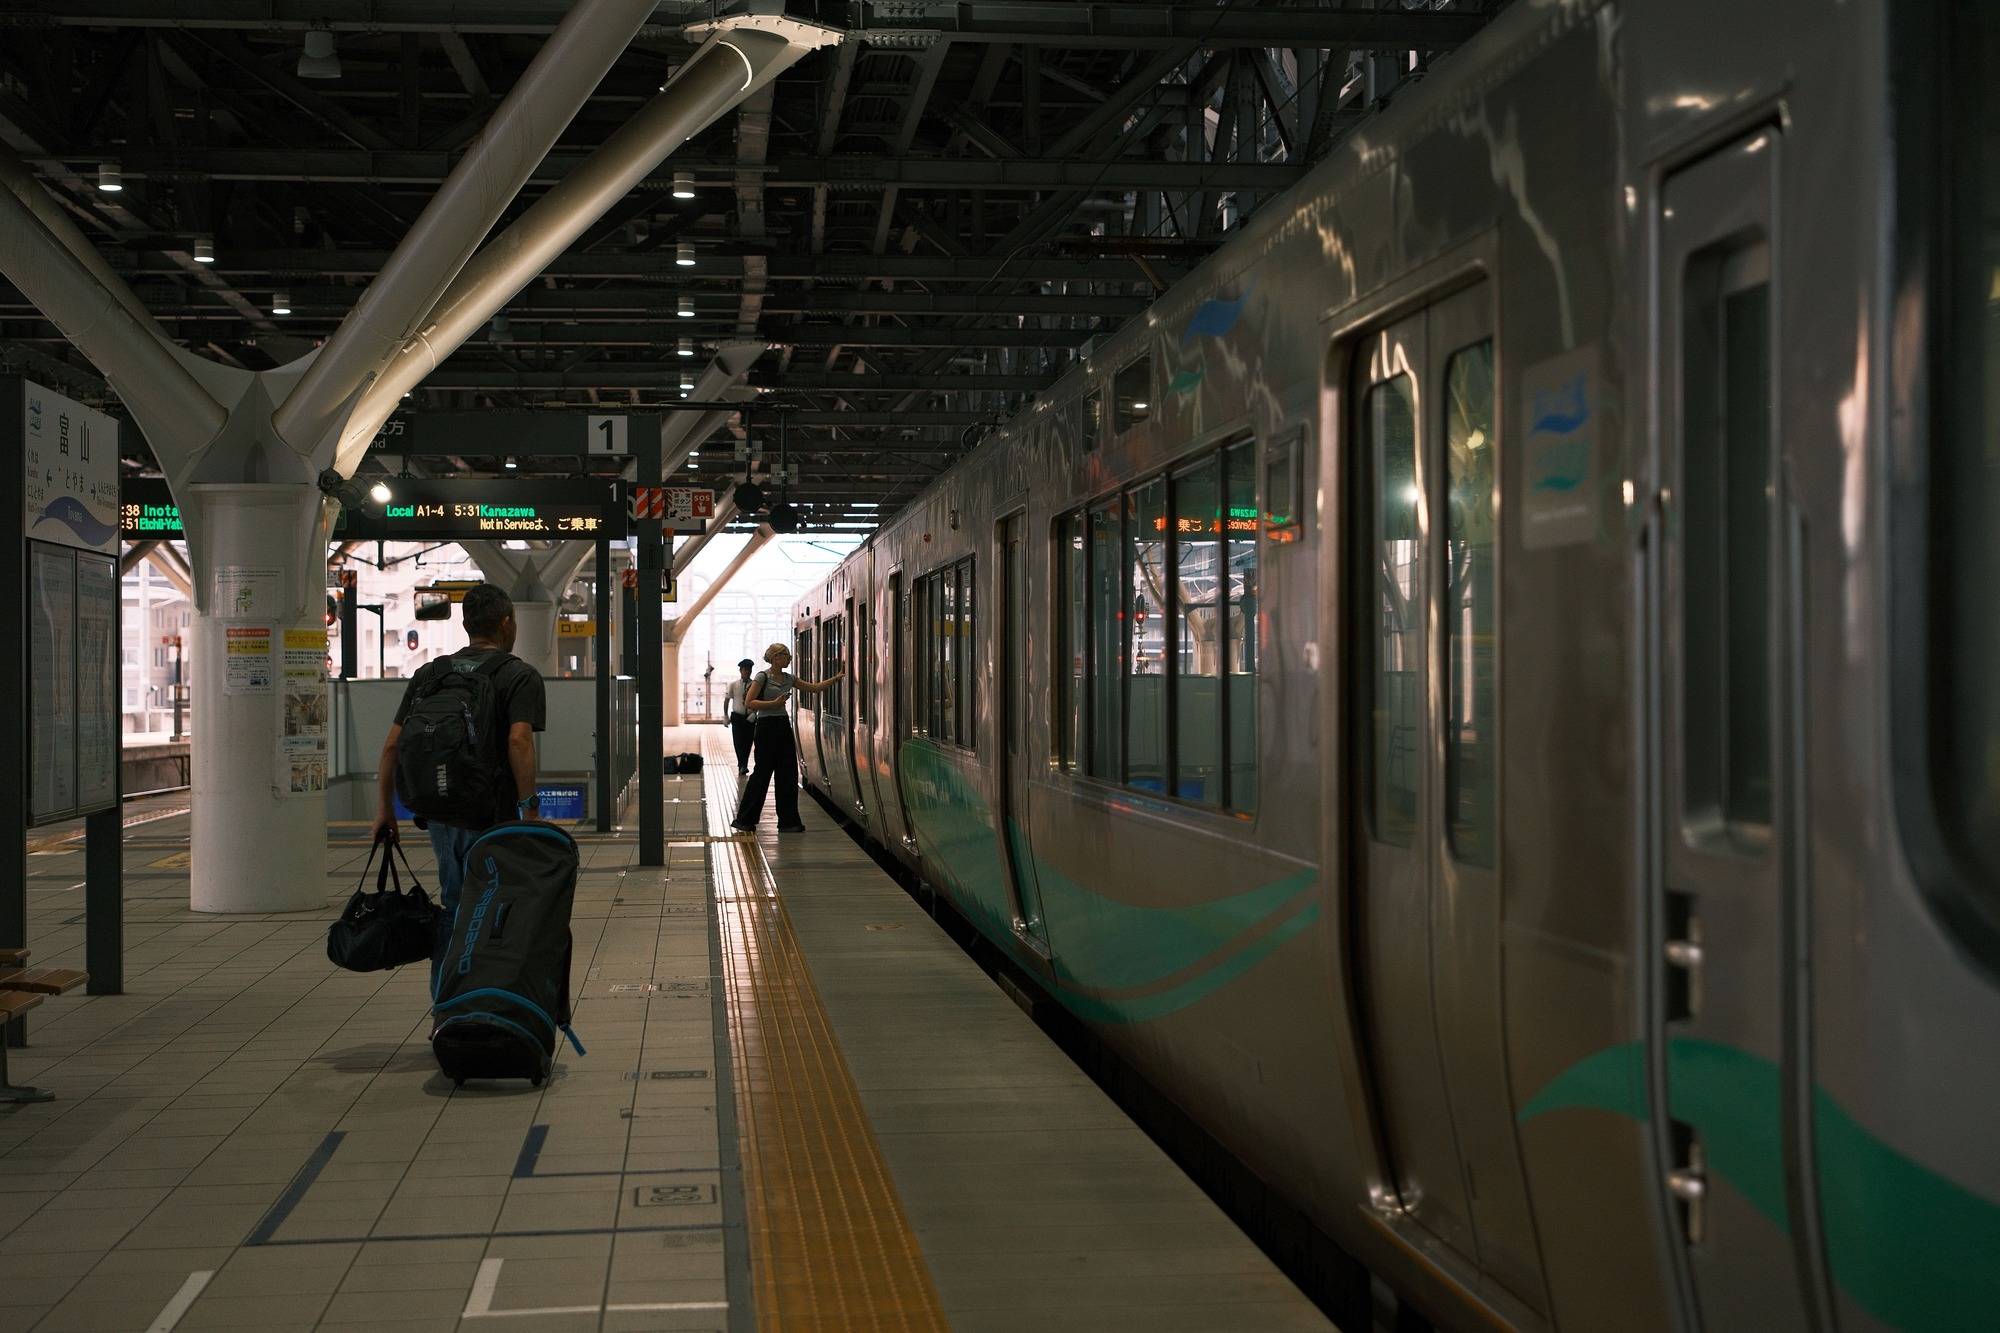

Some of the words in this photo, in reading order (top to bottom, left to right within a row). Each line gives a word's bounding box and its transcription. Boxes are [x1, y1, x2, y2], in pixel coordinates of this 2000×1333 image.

[59, 412, 90, 464] 富山
[598, 419, 614, 451] 1
[65, 468, 84, 493] とやま
[608, 482, 618, 503] 1
[694, 494, 711, 502] SOS
[386, 504, 414, 517] Local
[454, 504, 480, 517] 5:31
[480, 504, 536, 518] Kanazawa
[480, 518, 495, 531] Not
[495, 518, 503, 531] in
